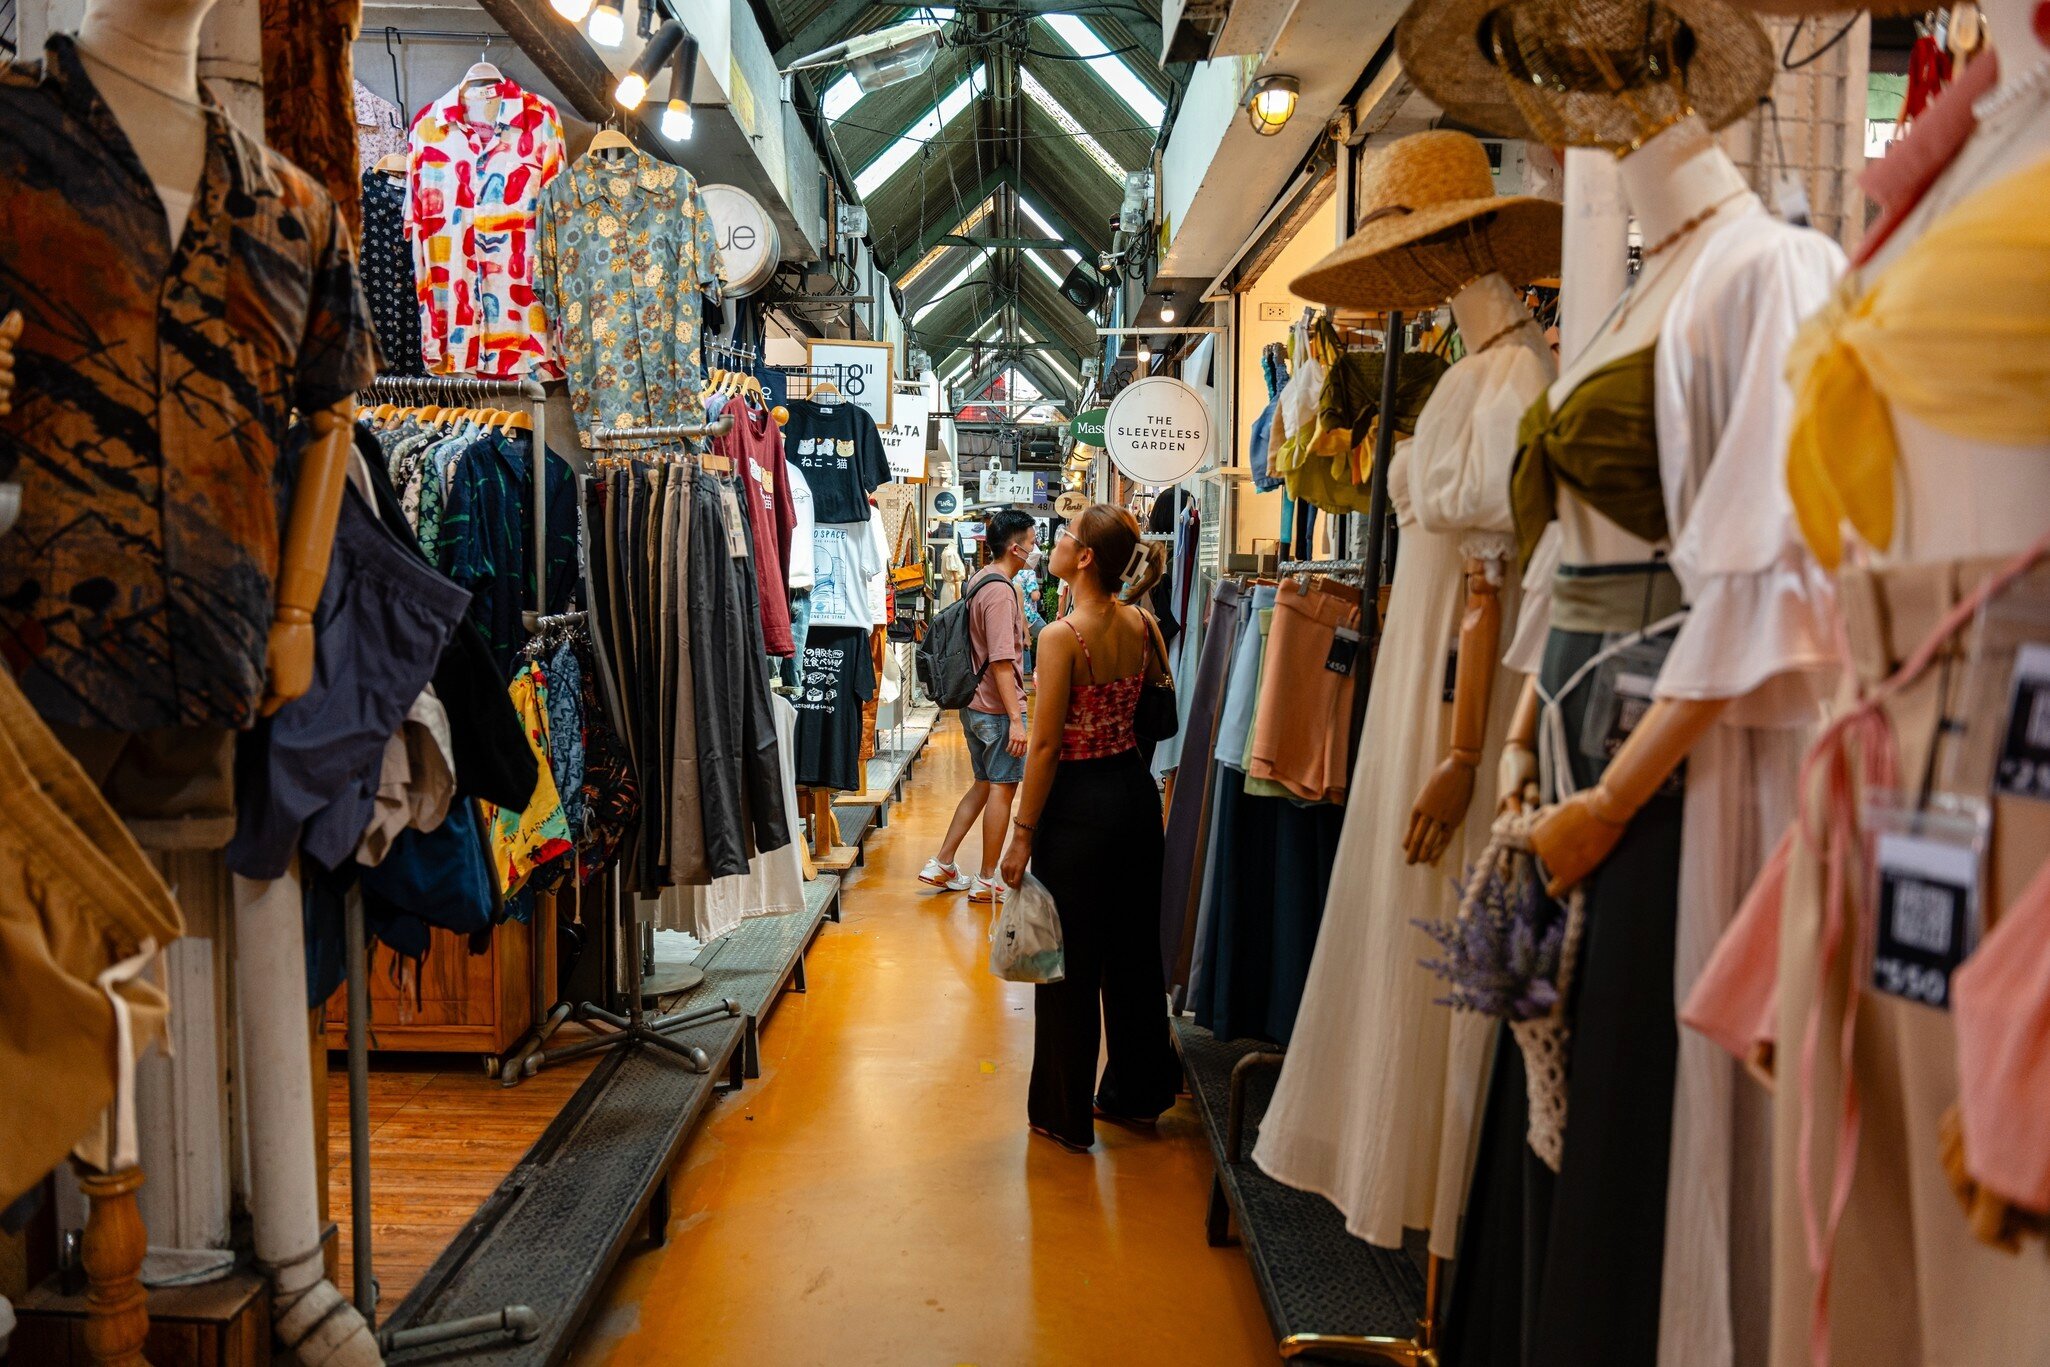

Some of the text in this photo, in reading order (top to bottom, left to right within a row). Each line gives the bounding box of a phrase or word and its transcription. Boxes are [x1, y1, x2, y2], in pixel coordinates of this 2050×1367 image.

[1147, 415, 1172, 425] THE
[1117, 427, 1200, 440] SLEEVELESS
[1131, 440, 1186, 451] GARDEN
[820, 530, 846, 540] SPACE
